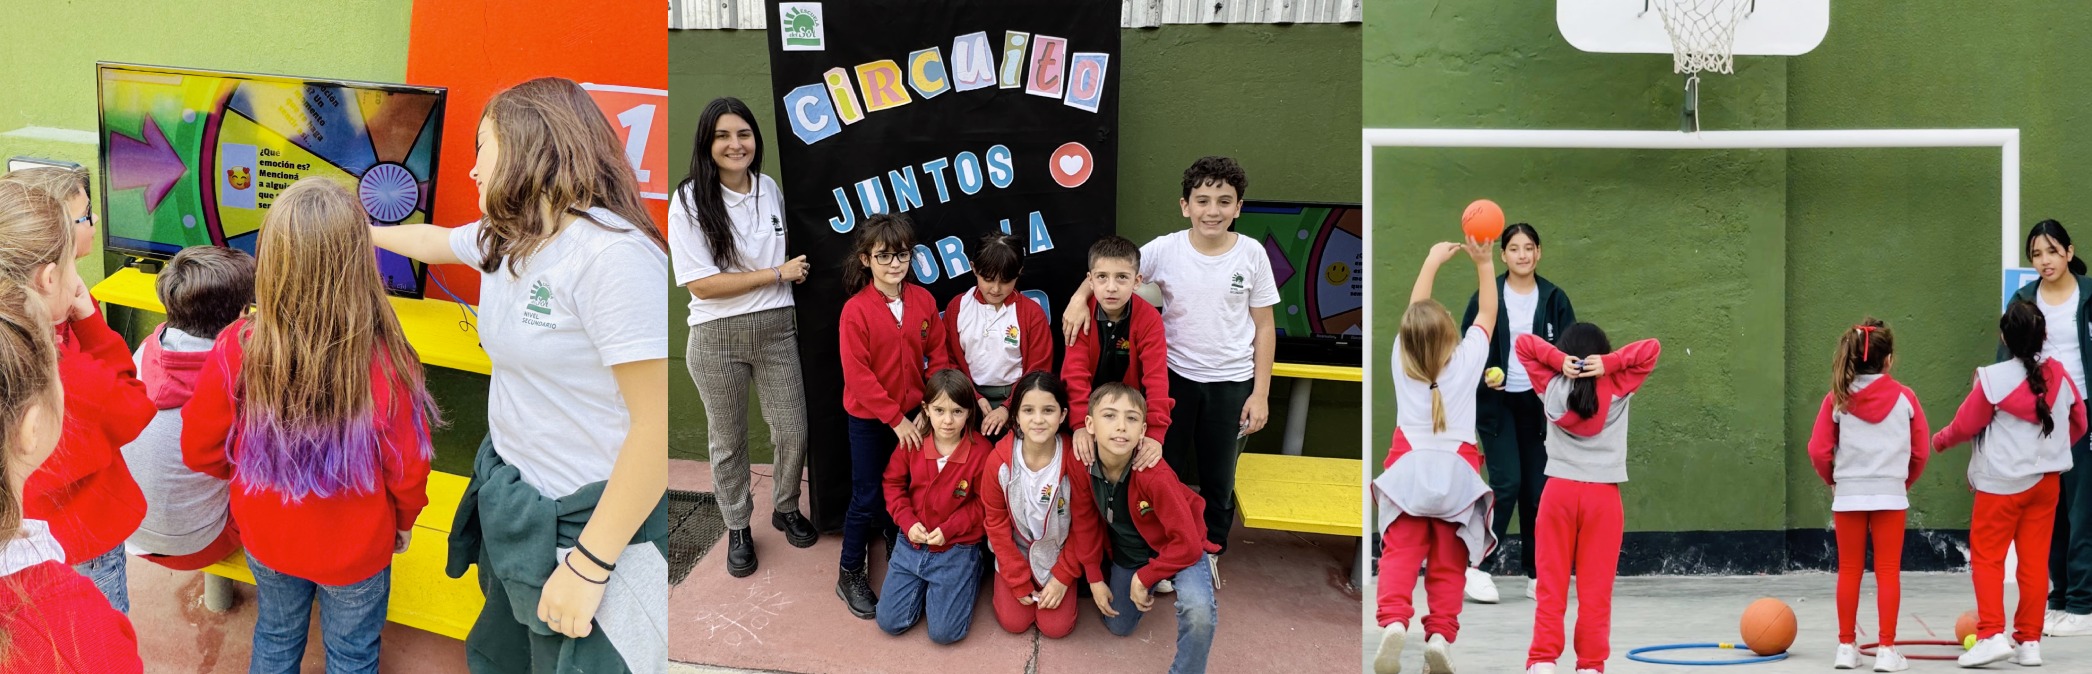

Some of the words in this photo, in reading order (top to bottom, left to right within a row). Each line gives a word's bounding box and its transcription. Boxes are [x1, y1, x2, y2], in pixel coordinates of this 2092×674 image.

[318, 86, 339, 108] oción
[617, 103, 657, 183] 1
[259, 160, 295, 170] emoción
[296, 162, 311, 171] es?
[259, 169, 299, 181] Mencioná
[829, 144, 1014, 233] JUNTOS
[258, 191, 274, 200] que
[912, 235, 973, 286] OR
[524, 311, 539, 319] NIVEL
[522, 318, 556, 329] SECUNDARIO
